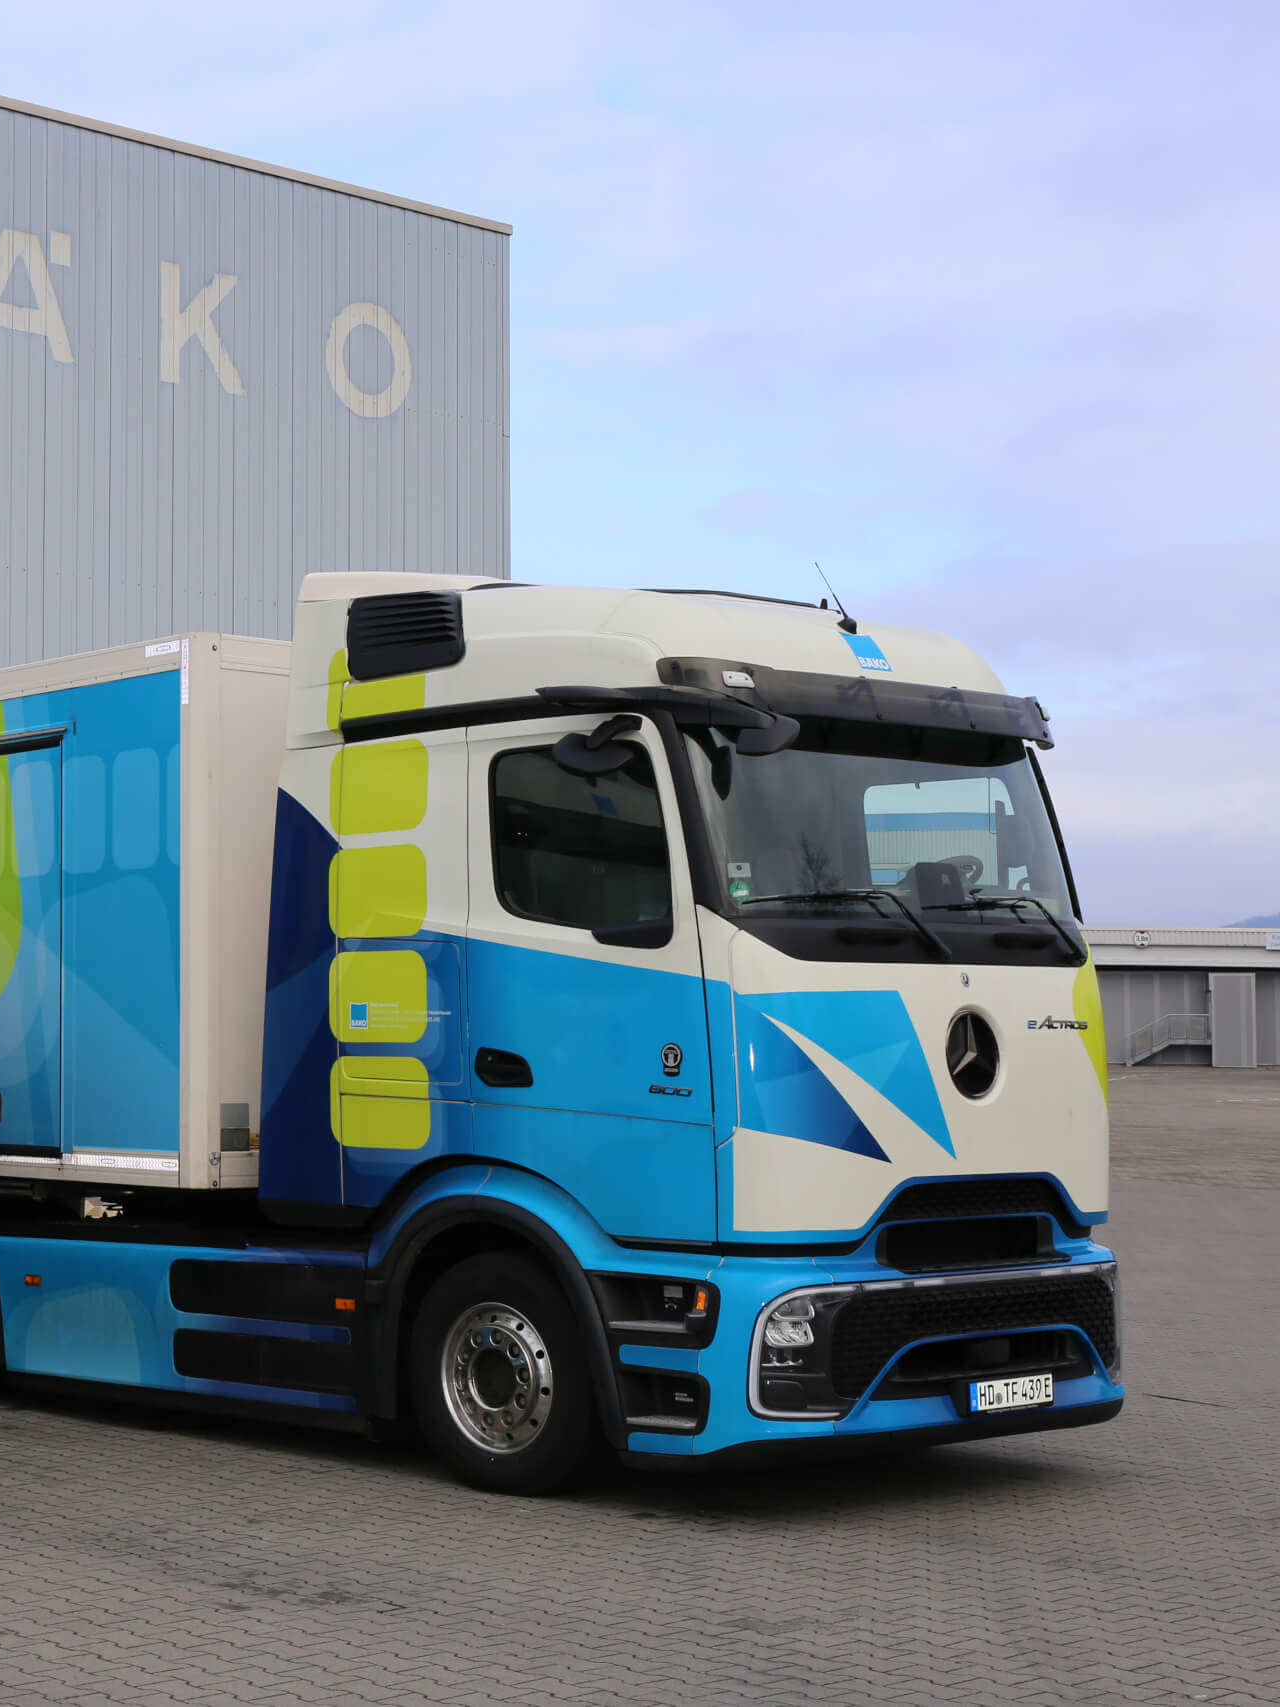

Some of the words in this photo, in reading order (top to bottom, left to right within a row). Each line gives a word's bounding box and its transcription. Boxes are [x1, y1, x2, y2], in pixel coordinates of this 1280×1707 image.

[649, 1084, 693, 1098] 600
[980, 1384, 994, 1406] HD
[1003, 1382, 1018, 1403] TF
